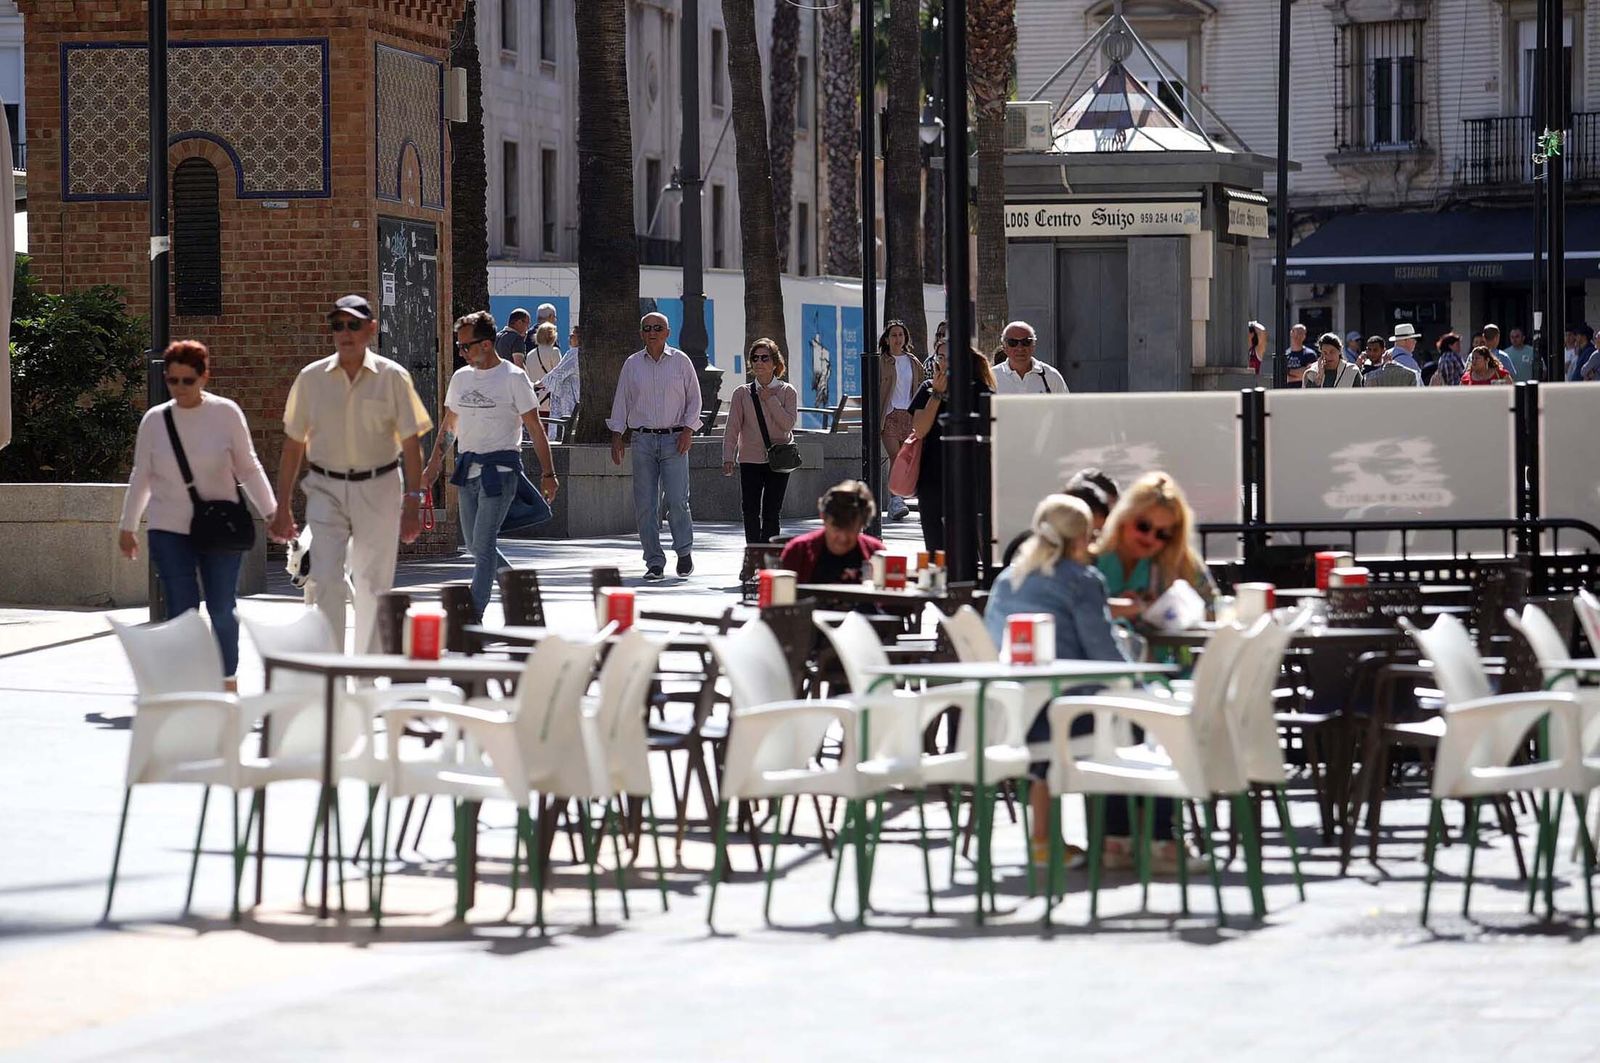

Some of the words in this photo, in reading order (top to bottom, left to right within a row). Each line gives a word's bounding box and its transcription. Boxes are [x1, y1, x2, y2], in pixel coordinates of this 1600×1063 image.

[1035, 209, 1081, 227] Centro
[1091, 207, 1135, 230] Suizo
[1140, 213, 1153, 224] 959
[1155, 213, 1168, 224] 254
[1170, 213, 1183, 224] 142
